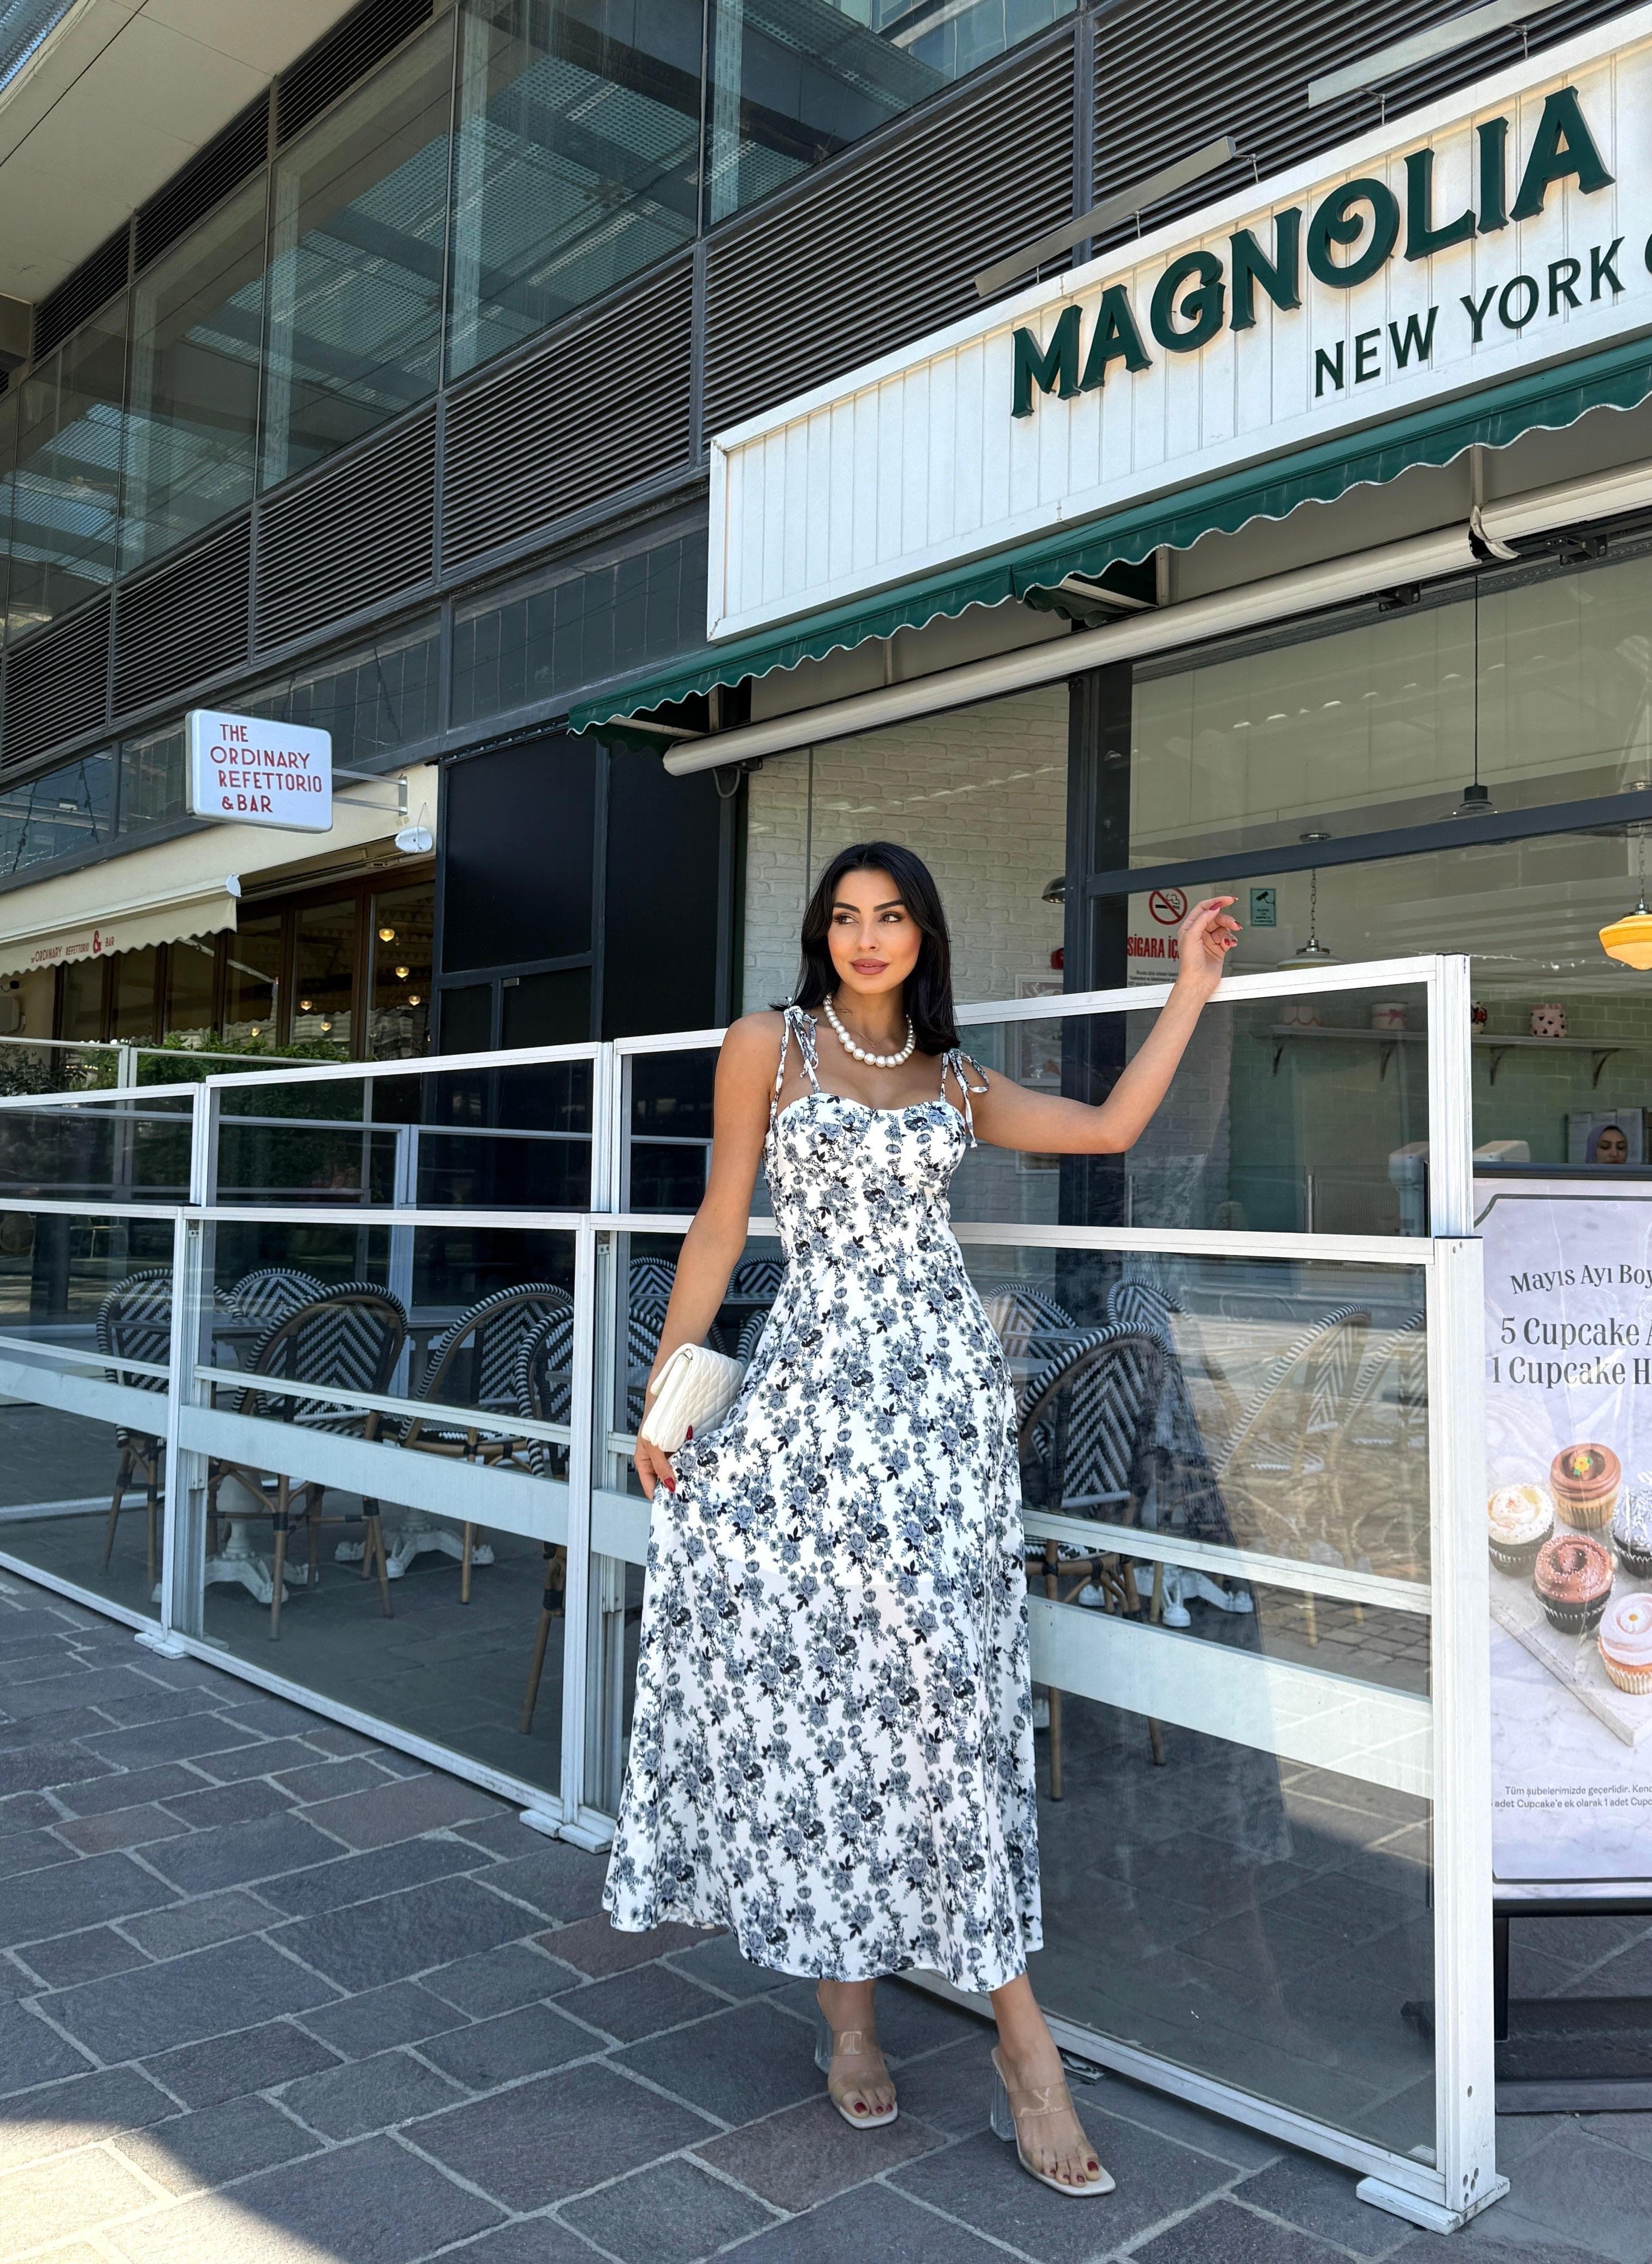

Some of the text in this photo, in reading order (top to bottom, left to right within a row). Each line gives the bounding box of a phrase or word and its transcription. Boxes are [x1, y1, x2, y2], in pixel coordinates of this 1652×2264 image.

[1011, 85, 1615, 419] MAGNOLIA
[1315, 305, 1439, 398] NEW
[1459, 236, 1626, 344] YORK
[220, 724, 249, 742] THE
[210, 746, 310, 769] ORDINARY
[219, 770, 322, 793] REFETTORIO
[35, 946, 62, 962] ORDINARY
[93, 930, 102, 954] &
[1127, 934, 1165, 958] SİGARA
[1509, 1269, 1576, 1294] Mayıs
[1580, 1265, 1613, 1287] Ayı
[1501, 1317, 1515, 1345] 5
[1524, 1318, 1639, 1350] Cupcake
[1491, 1356, 1501, 1383] 1
[1509, 1356, 1625, 1389] Cupcake
[1495, 1799, 1515, 1808] adet
[1517, 1798, 1563, 1809] Cupcake'e
[1564, 1799, 1575, 1808] ek
[1576, 1798, 1603, 1807] olarak
[1604, 1797, 1608, 1806] 1
[1609, 1797, 1629, 1806] adet
[1504, 1785, 1525, 1795] Tüm
[1527, 1785, 1586, 1797] şubelerimizde
[1588, 1784, 1631, 1796] geçerlidir.
